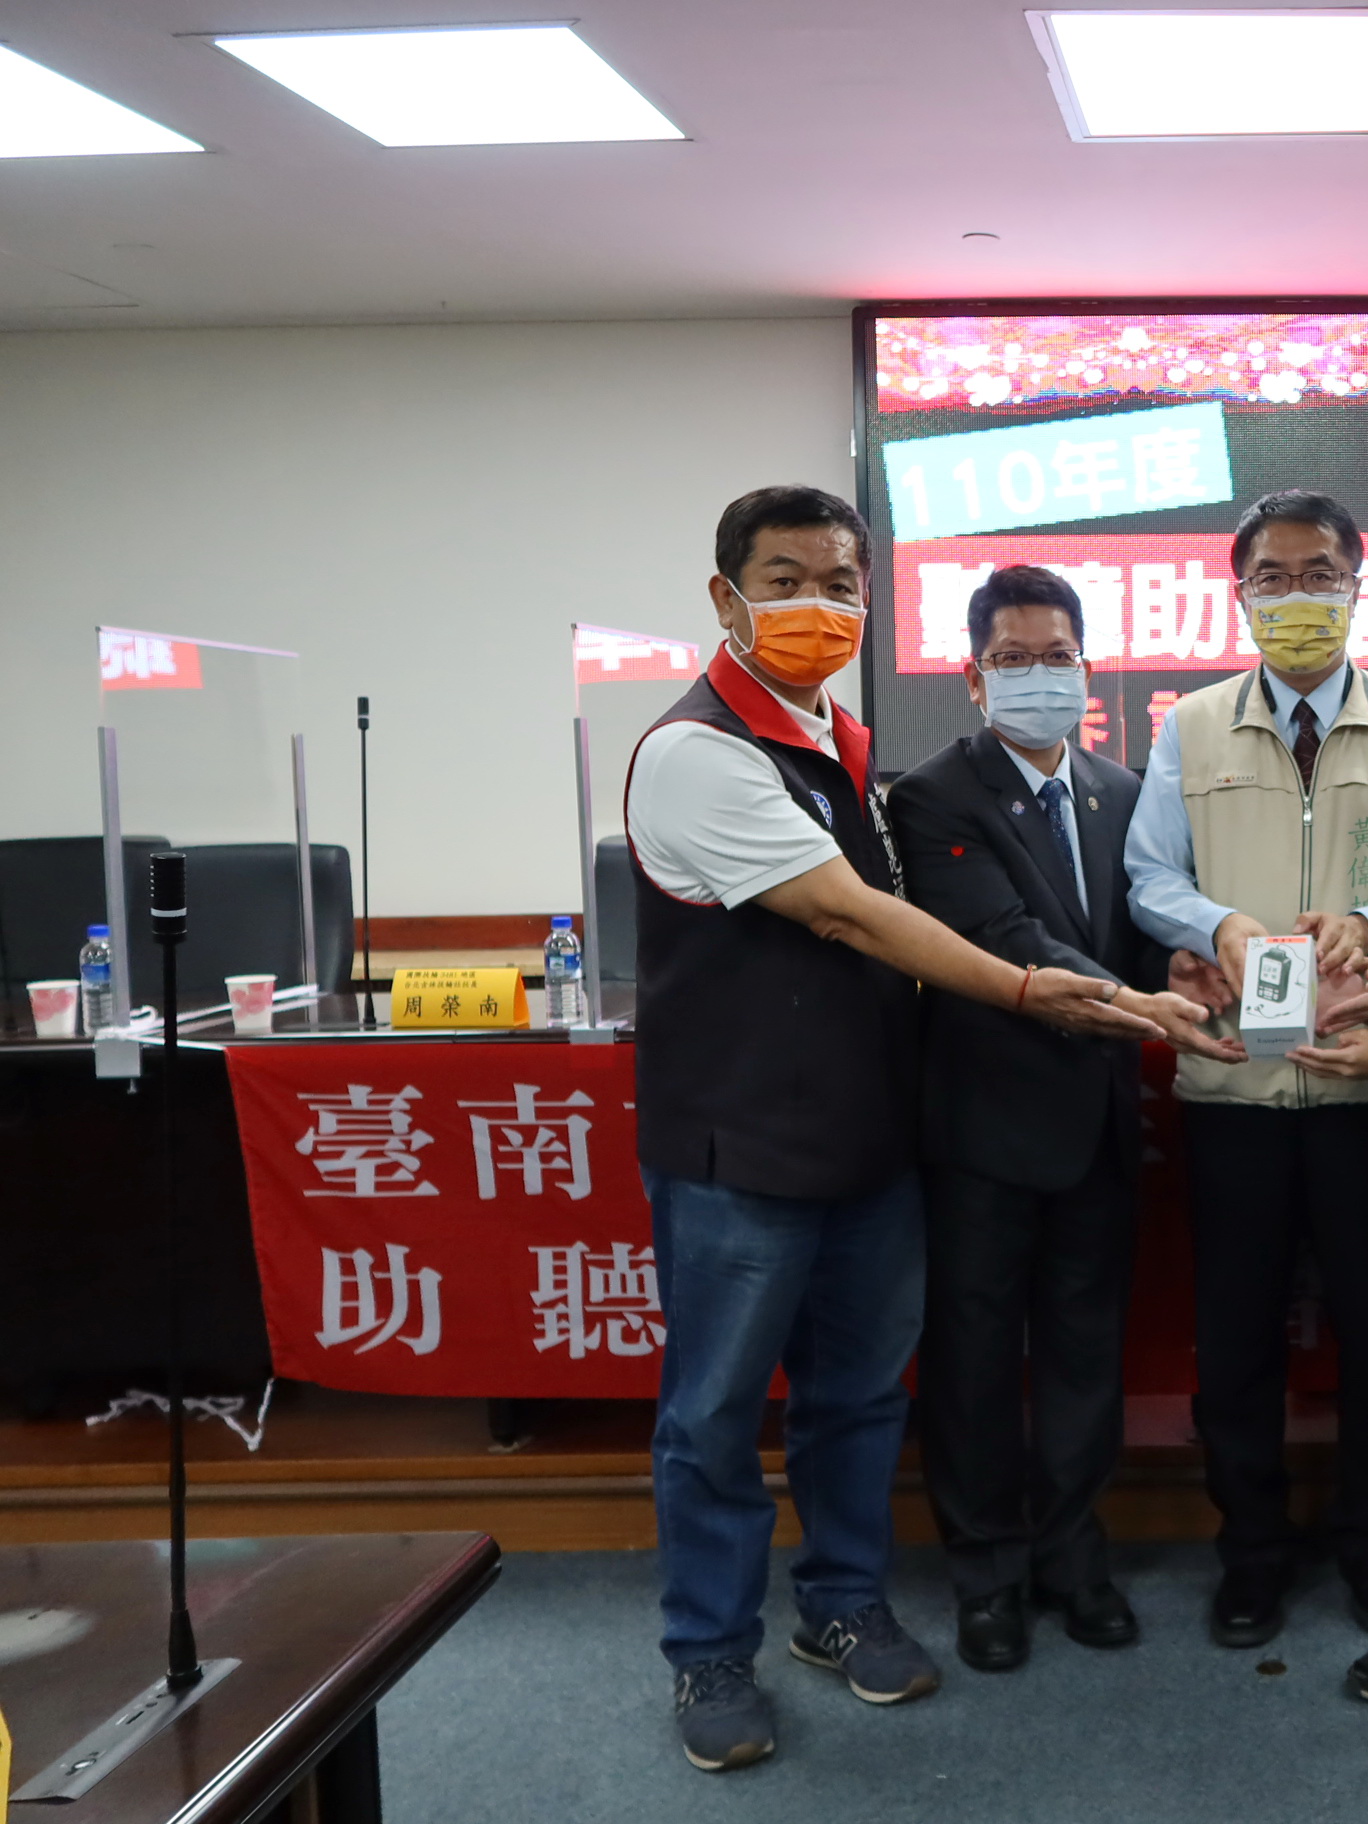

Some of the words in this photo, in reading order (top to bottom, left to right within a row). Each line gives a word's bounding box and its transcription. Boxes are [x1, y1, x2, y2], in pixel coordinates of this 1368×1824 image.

[901, 427, 1208, 526] 110年度
[403, 993, 498, 1018] 周榮南
[295, 1083, 635, 1200] 臺南
